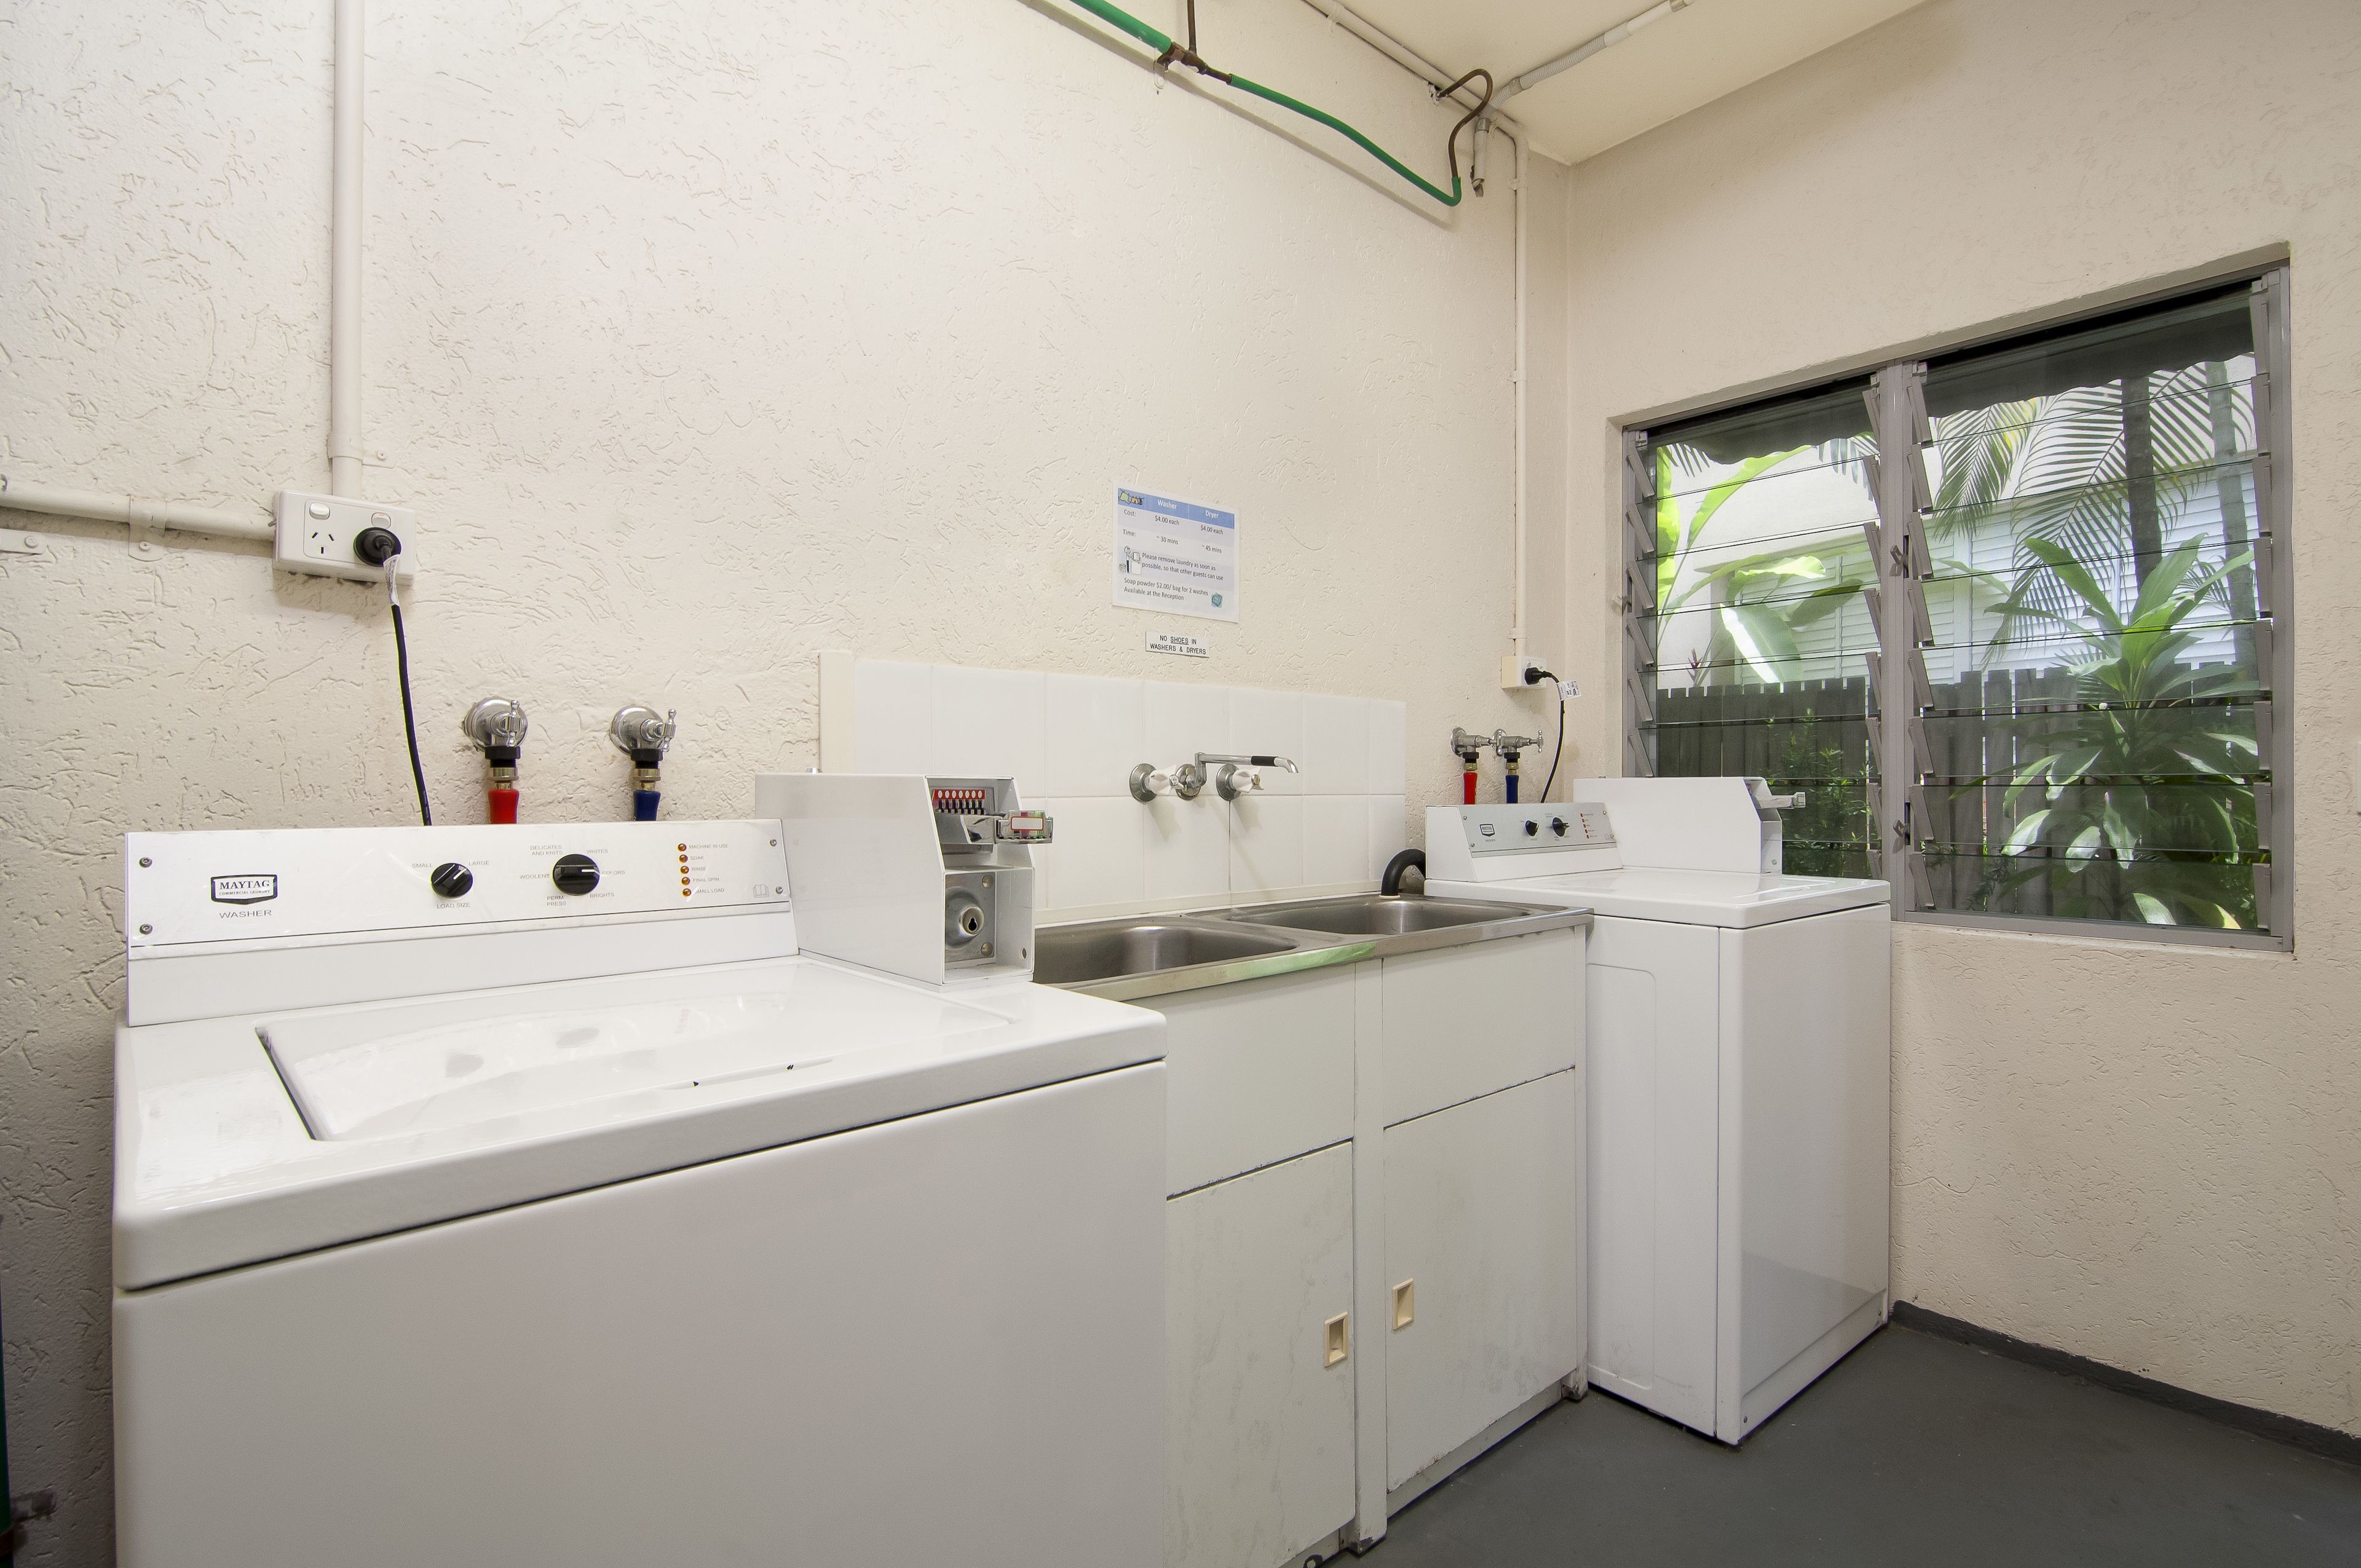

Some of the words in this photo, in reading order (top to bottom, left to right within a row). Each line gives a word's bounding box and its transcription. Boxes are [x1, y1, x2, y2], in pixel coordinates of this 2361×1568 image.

[1123, 509, 1136, 517] Cost:
[1157, 499, 1177, 510] Washer
[1205, 510, 1219, 519] Dryer
[1123, 528, 1136, 537] Time:
[1200, 525, 1212, 533] $4.00
[1142, 552, 1157, 561] Please
[1176, 558, 1193, 568] laundry
[1142, 562, 1163, 571] possible,
[1156, 582, 1172, 591] $2.00/
[1172, 584, 1181, 593] bag
[1124, 587, 1145, 595] Available
[1161, 592, 1184, 601] Reception
[1150, 643, 1176, 652] WASHERS
[219, 880, 270, 890] MAYTAG
[219, 910, 272, 919] WASHER
